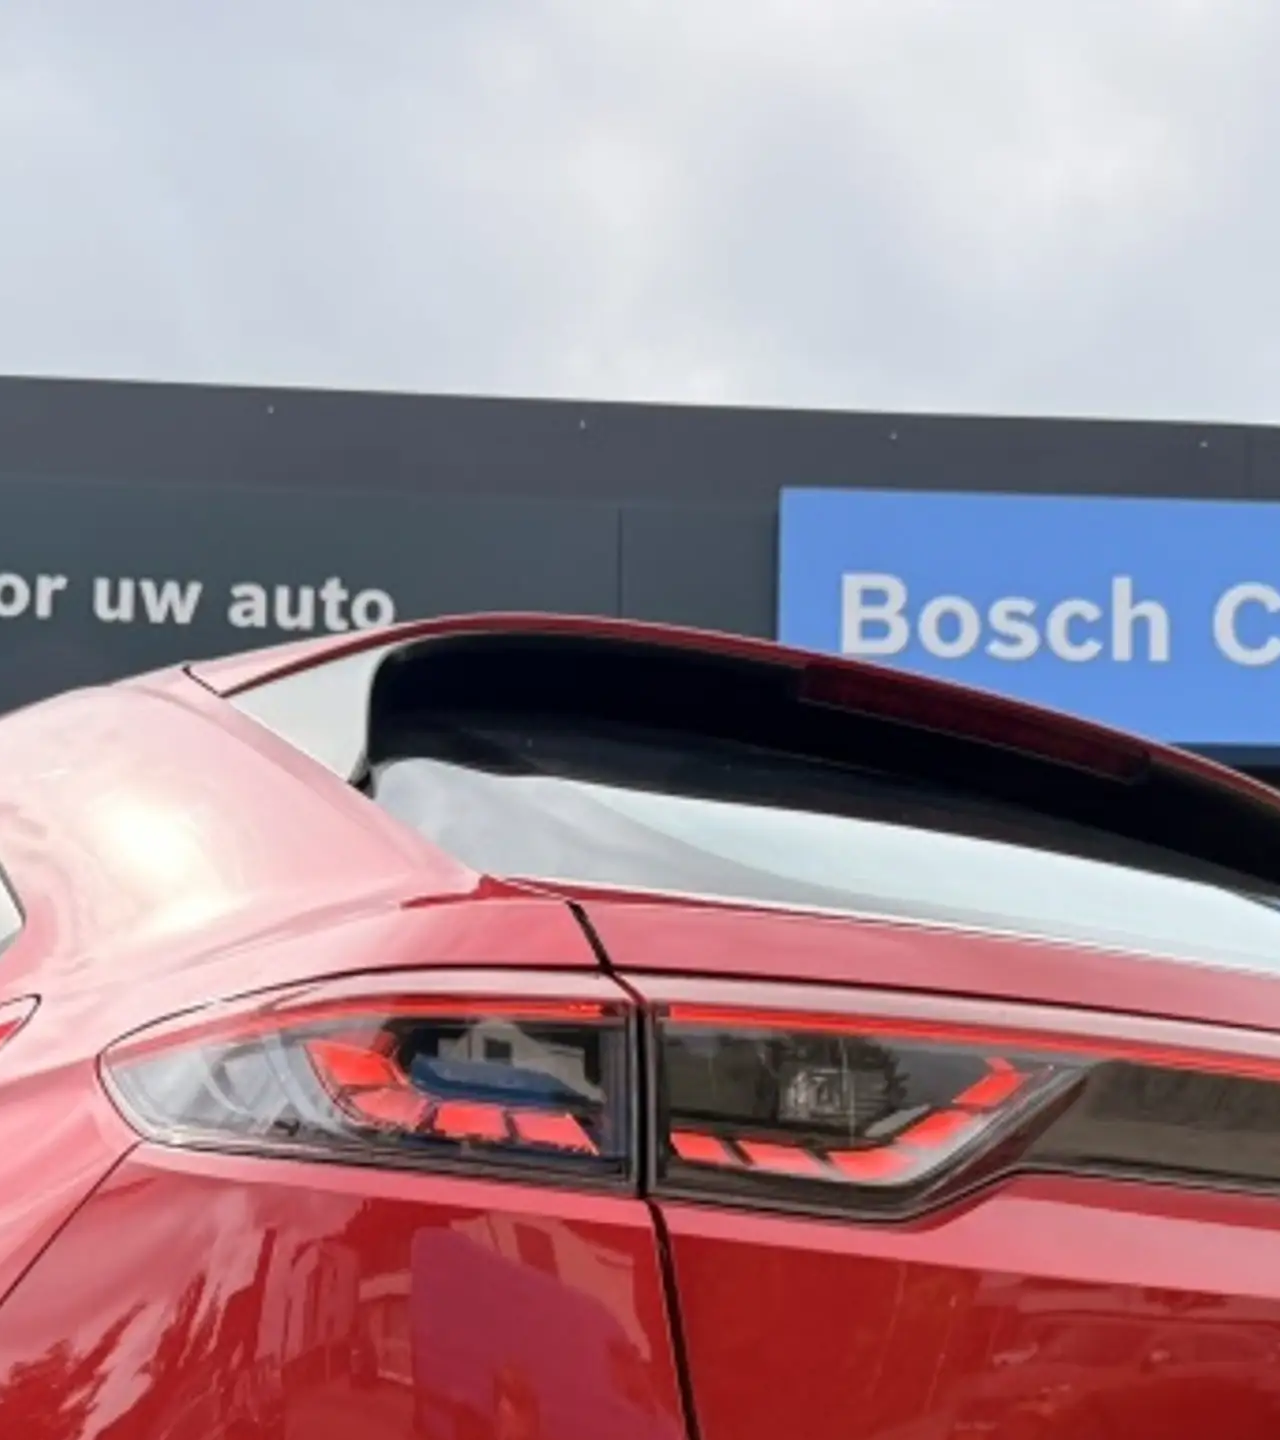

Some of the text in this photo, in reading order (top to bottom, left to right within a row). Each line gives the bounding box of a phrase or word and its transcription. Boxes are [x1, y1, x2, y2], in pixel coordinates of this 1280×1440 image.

[93, 576, 203, 624] uw
[228, 576, 396, 631] auto
[840, 573, 1170, 661] Bosch
